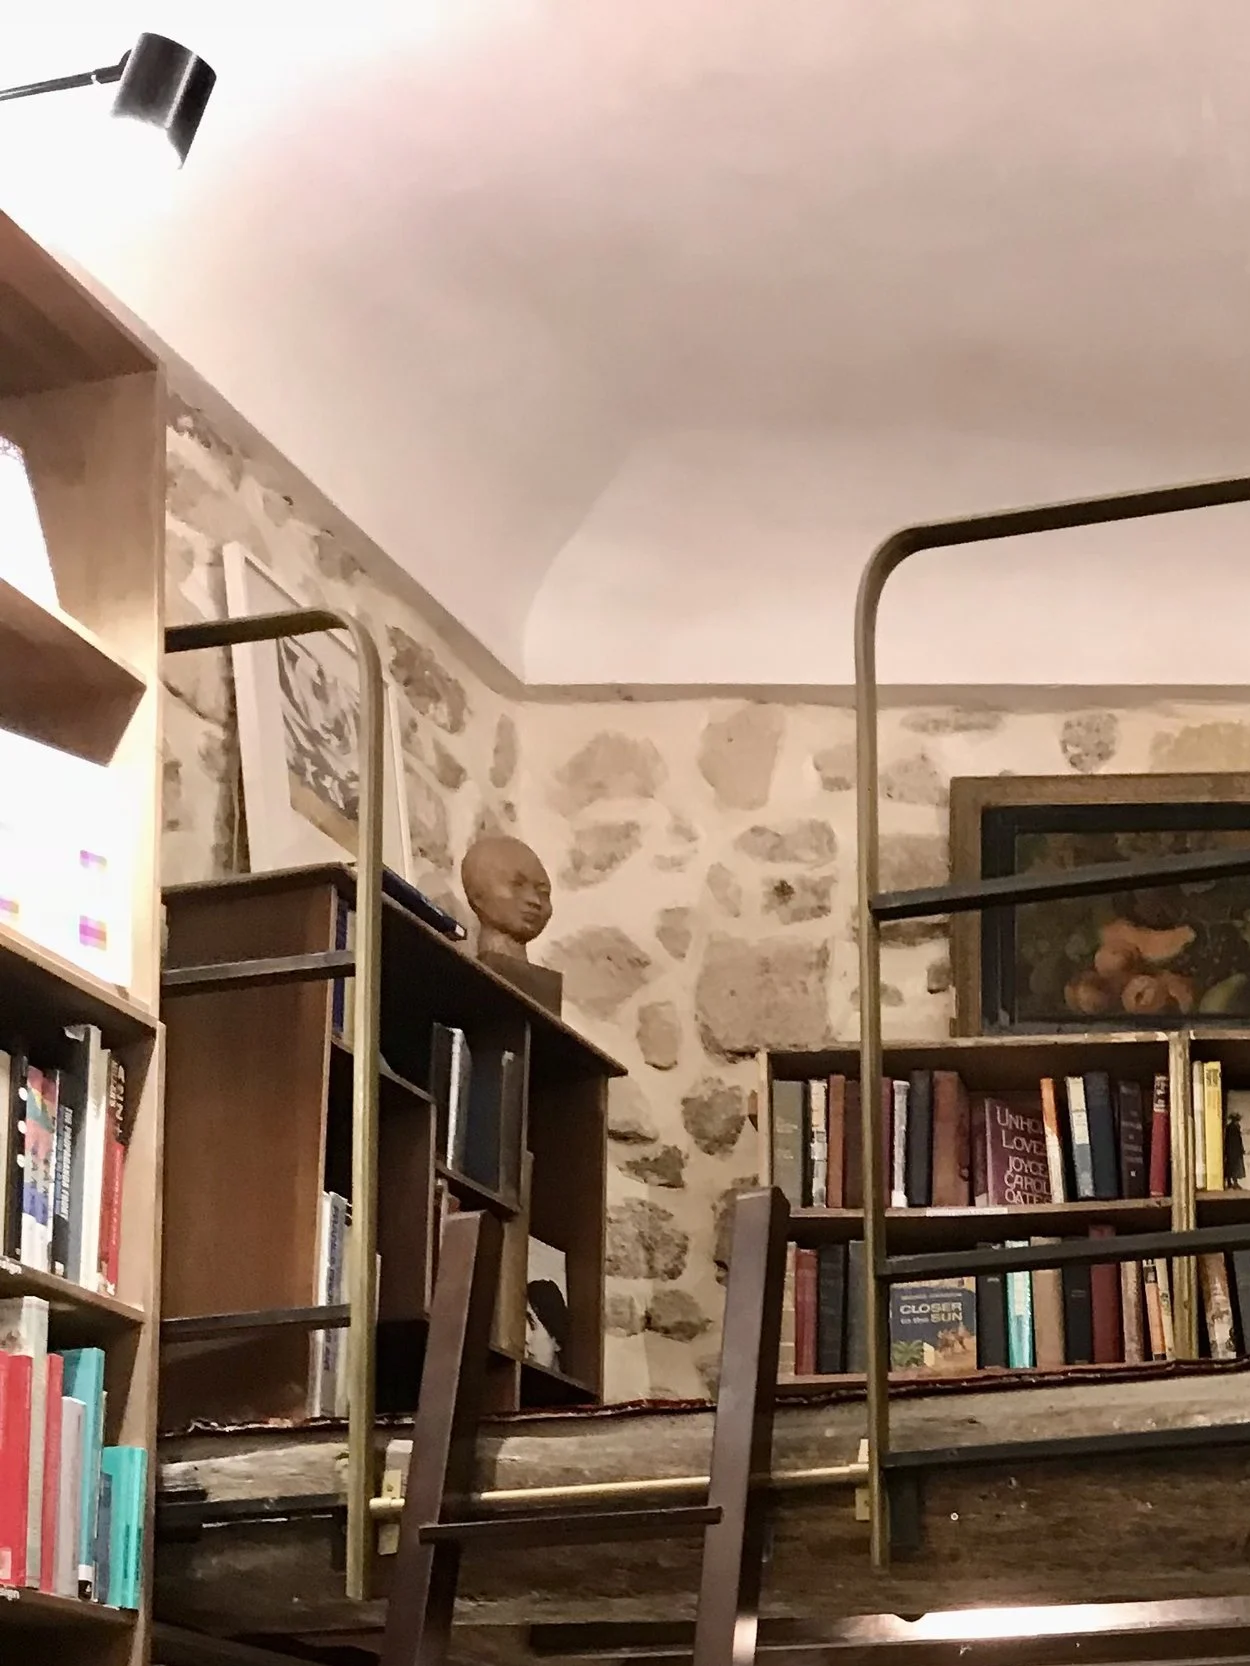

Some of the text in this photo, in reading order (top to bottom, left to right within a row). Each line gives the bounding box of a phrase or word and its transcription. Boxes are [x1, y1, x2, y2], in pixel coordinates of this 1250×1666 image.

[1002, 1129, 1046, 1155] LOVE
[59, 1106, 73, 1219] THE PROPAGANDA FRONT
[1008, 1155, 1048, 1177] JOYCE
[1004, 1170, 1051, 1195] CAROL
[900, 1302, 962, 1314] CLOSER
[930, 1312, 963, 1323] SUN
